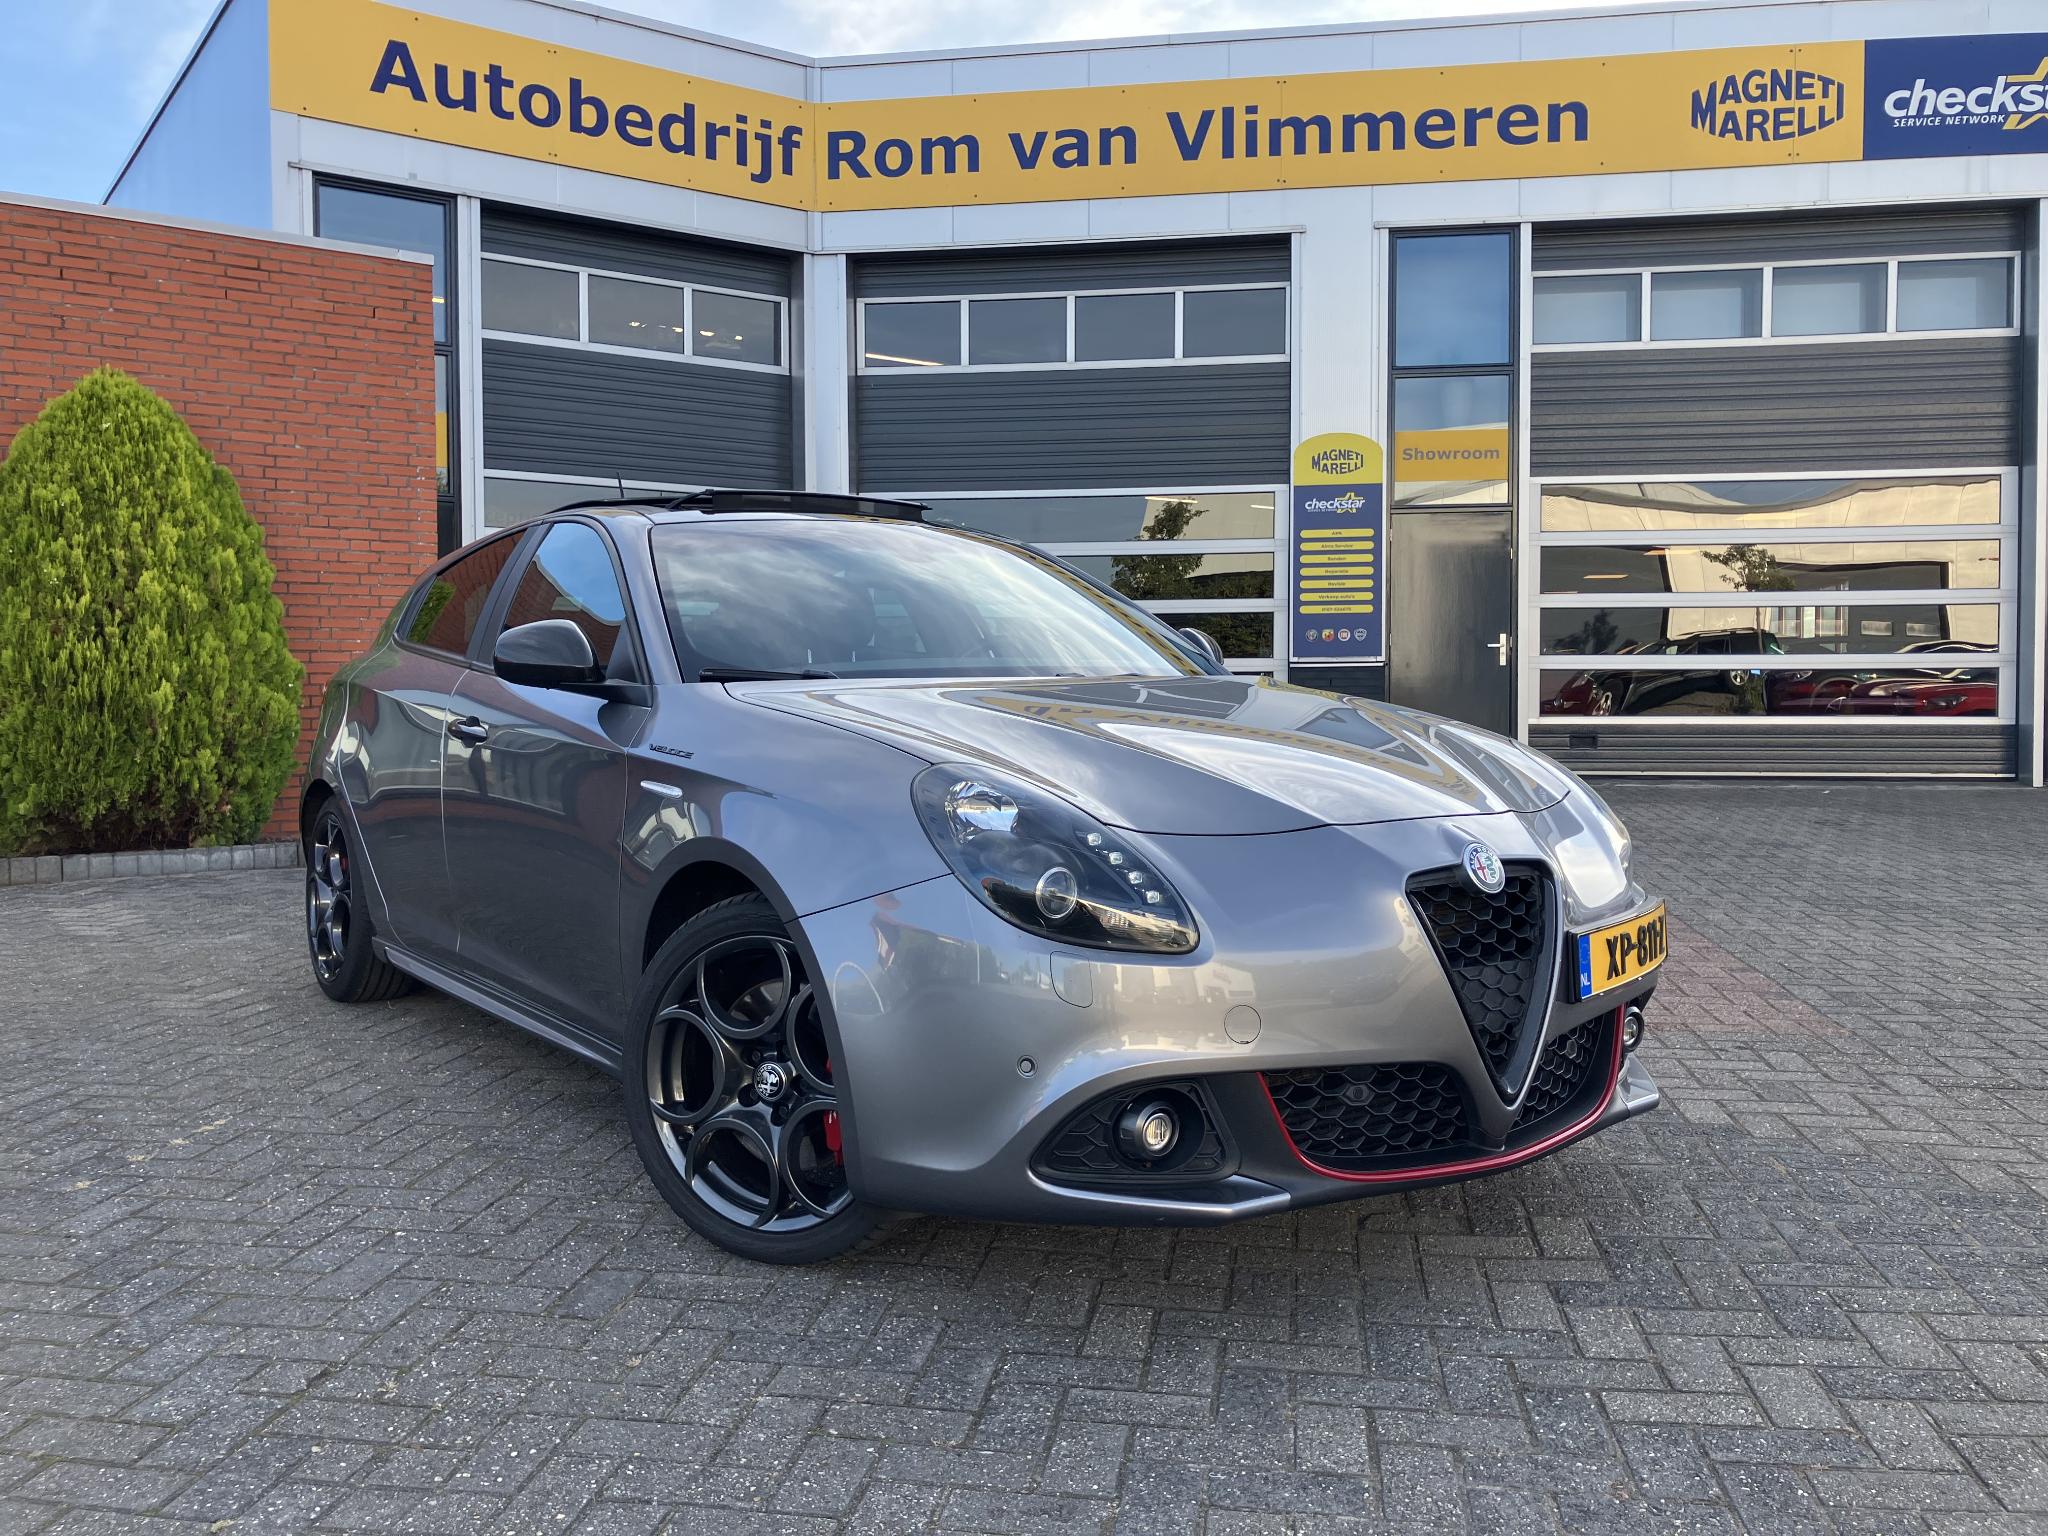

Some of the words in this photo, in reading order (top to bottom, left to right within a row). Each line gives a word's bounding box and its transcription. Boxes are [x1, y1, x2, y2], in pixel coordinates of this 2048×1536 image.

[1692, 68, 1844, 122] MAGNETI
[1884, 75, 2048, 118] checks
[369, 39, 803, 184] Autobedrijf
[826, 130, 980, 180] Rom
[1008, 125, 1137, 170] van
[1166, 101, 1589, 162] Vlimmeren
[1692, 94, 1844, 142] MARELLI
[1893, 117, 1942, 128] SERVICE
[1945, 114, 2005, 125] NETWORK
[1312, 449, 1364, 466] MAGNETI
[1402, 447, 1500, 461] Showroom
[1312, 457, 1364, 475] MARELLI
[1304, 497, 1366, 510] checkstar
[1580, 972, 1591, 987] NL
